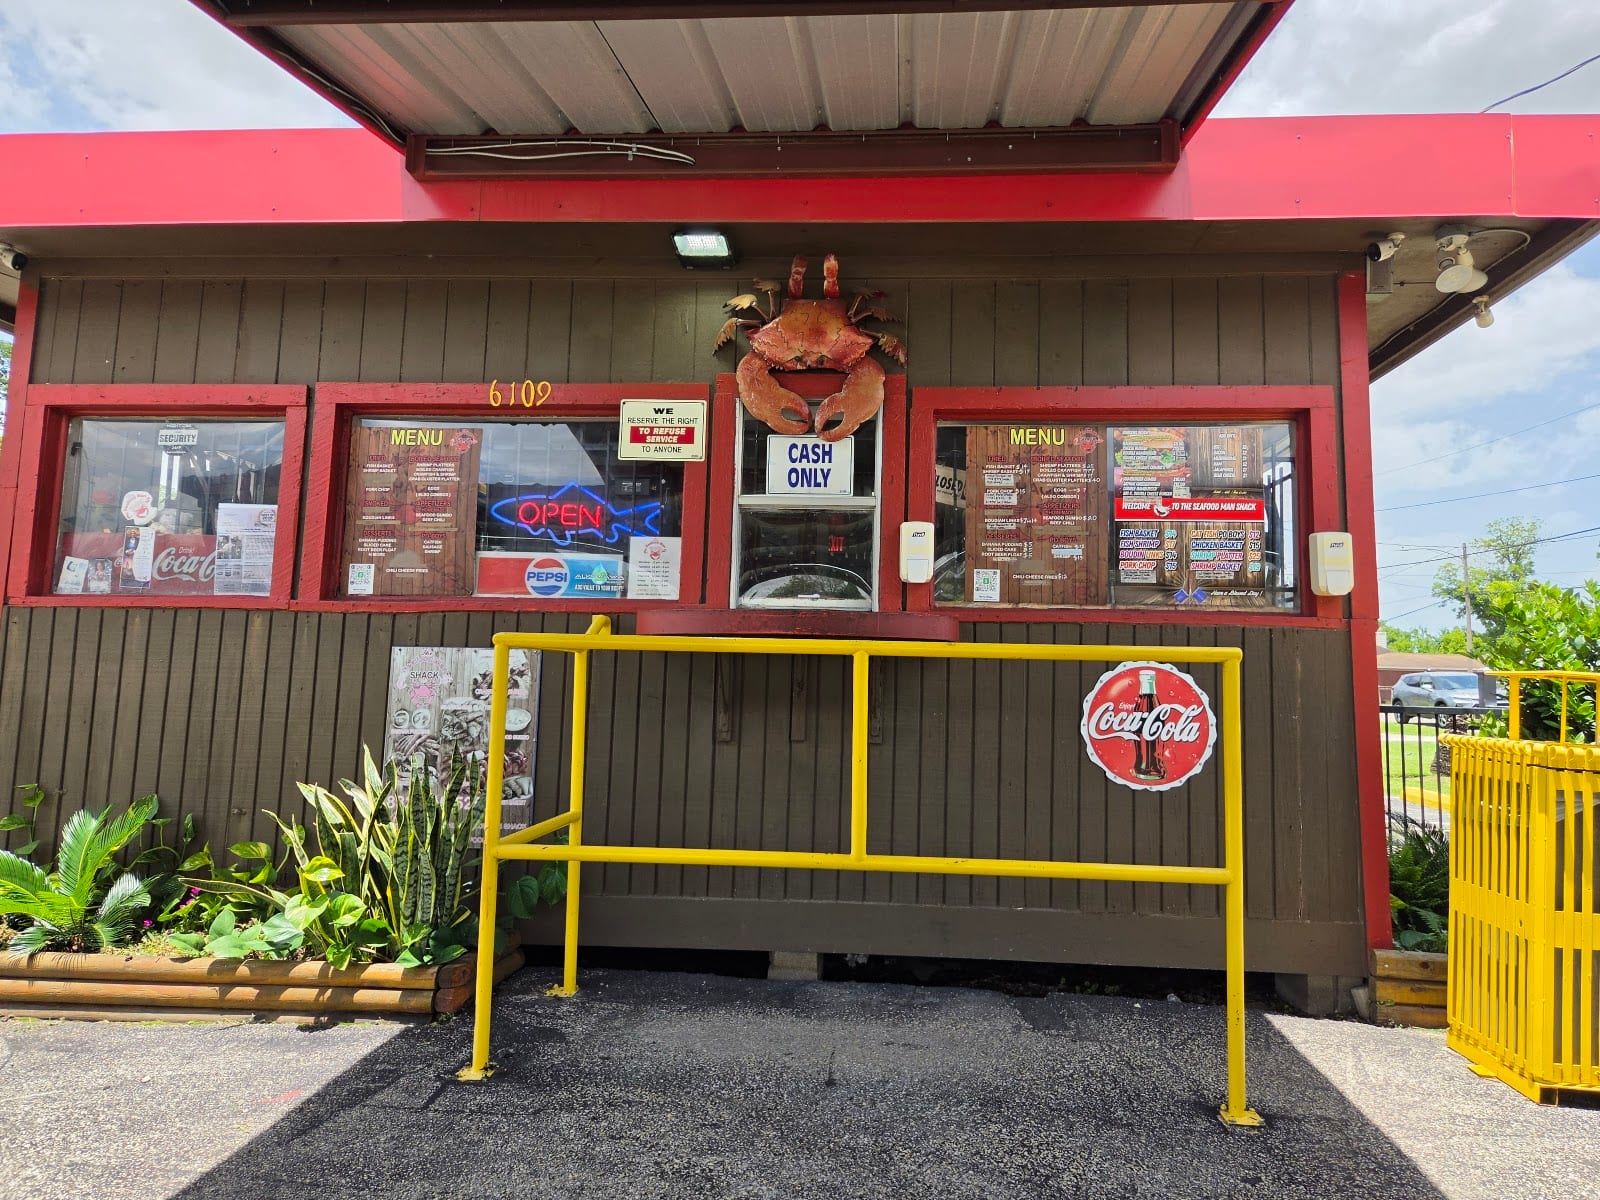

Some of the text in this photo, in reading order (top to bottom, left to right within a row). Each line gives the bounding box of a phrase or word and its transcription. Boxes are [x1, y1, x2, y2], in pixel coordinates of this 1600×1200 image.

[489, 379, 552, 408] 6109
[677, 417, 698, 425] RIGHT
[639, 427, 687, 435] TO REFUSE
[159, 434, 197, 443] SECURITY
[391, 429, 443, 446] MENU
[645, 435, 678, 443] SERVICE
[1010, 428, 1065, 446] MENU
[788, 442, 833, 464] CASH
[787, 467, 832, 488] ONLY
[1122, 502, 1151, 510] WELCOME
[1220, 503, 1235, 511] MAN
[1236, 503, 1257, 511] SHACK
[518, 501, 601, 528] OPEN
[1120, 529, 1177, 538] FISH BASKET $14
[1190, 530, 1260, 540] CAT FISH PO BOYS $12
[1119, 540, 1134, 548] FISH
[1134, 540, 1160, 548] SHRIMP
[1190, 541, 1261, 550] CHICKEN BASKET $15
[1119, 550, 1178, 560] BOUDIN LINKS $14
[1190, 551, 1261, 561] SHRIMP PLATTER $25
[152, 547, 217, 582] Coca-C
[1119, 561, 1178, 571] PORK CHOP $15
[1190, 561, 1216, 570] SHRIMP
[1216, 561, 1242, 570] BASKET
[526, 572, 568, 582] PEPSI
[410, 671, 439, 679] SHACK
[1088, 701, 1204, 742] Coca-Cola
